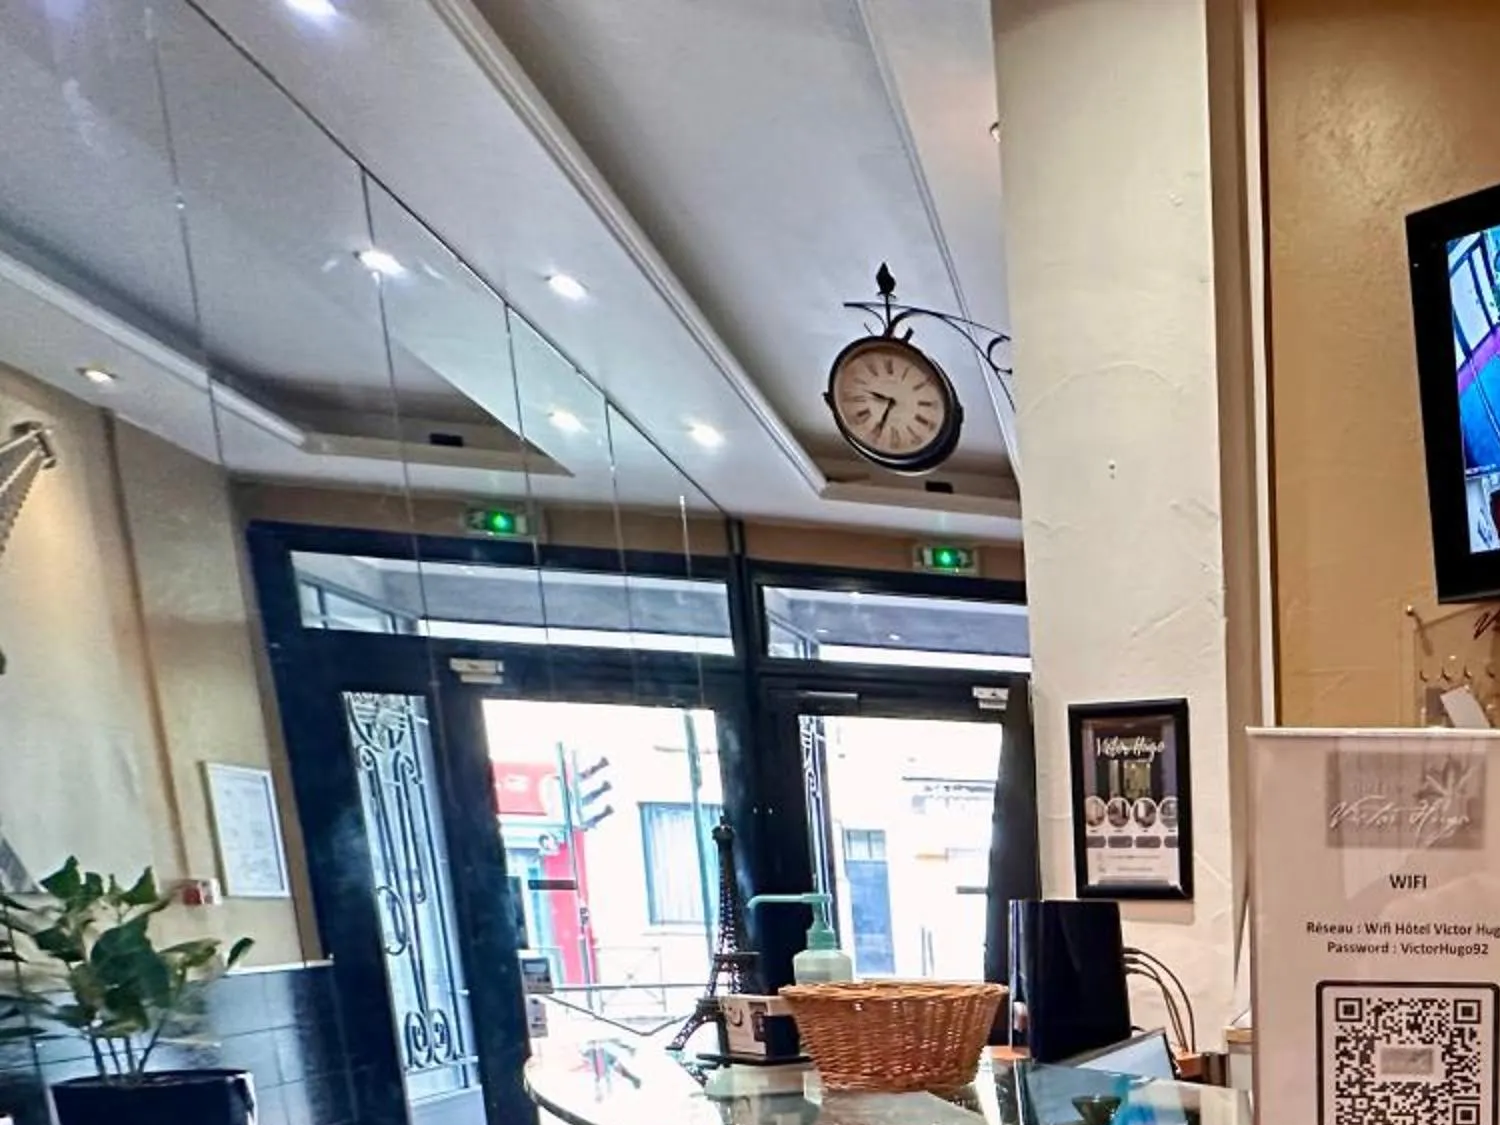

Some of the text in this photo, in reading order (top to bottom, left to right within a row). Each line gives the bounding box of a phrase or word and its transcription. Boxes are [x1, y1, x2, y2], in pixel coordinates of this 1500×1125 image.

[1389, 874, 1428, 889] WIFI
[1306, 921, 1353, 934] Réseau
[1364, 922, 1391, 935] Wifi
[1395, 922, 1430, 935] Hôtel
[1433, 923, 1472, 935] Victor
[1327, 941, 1390, 954] Password
[1400, 943, 1489, 957] VictorHugo92
